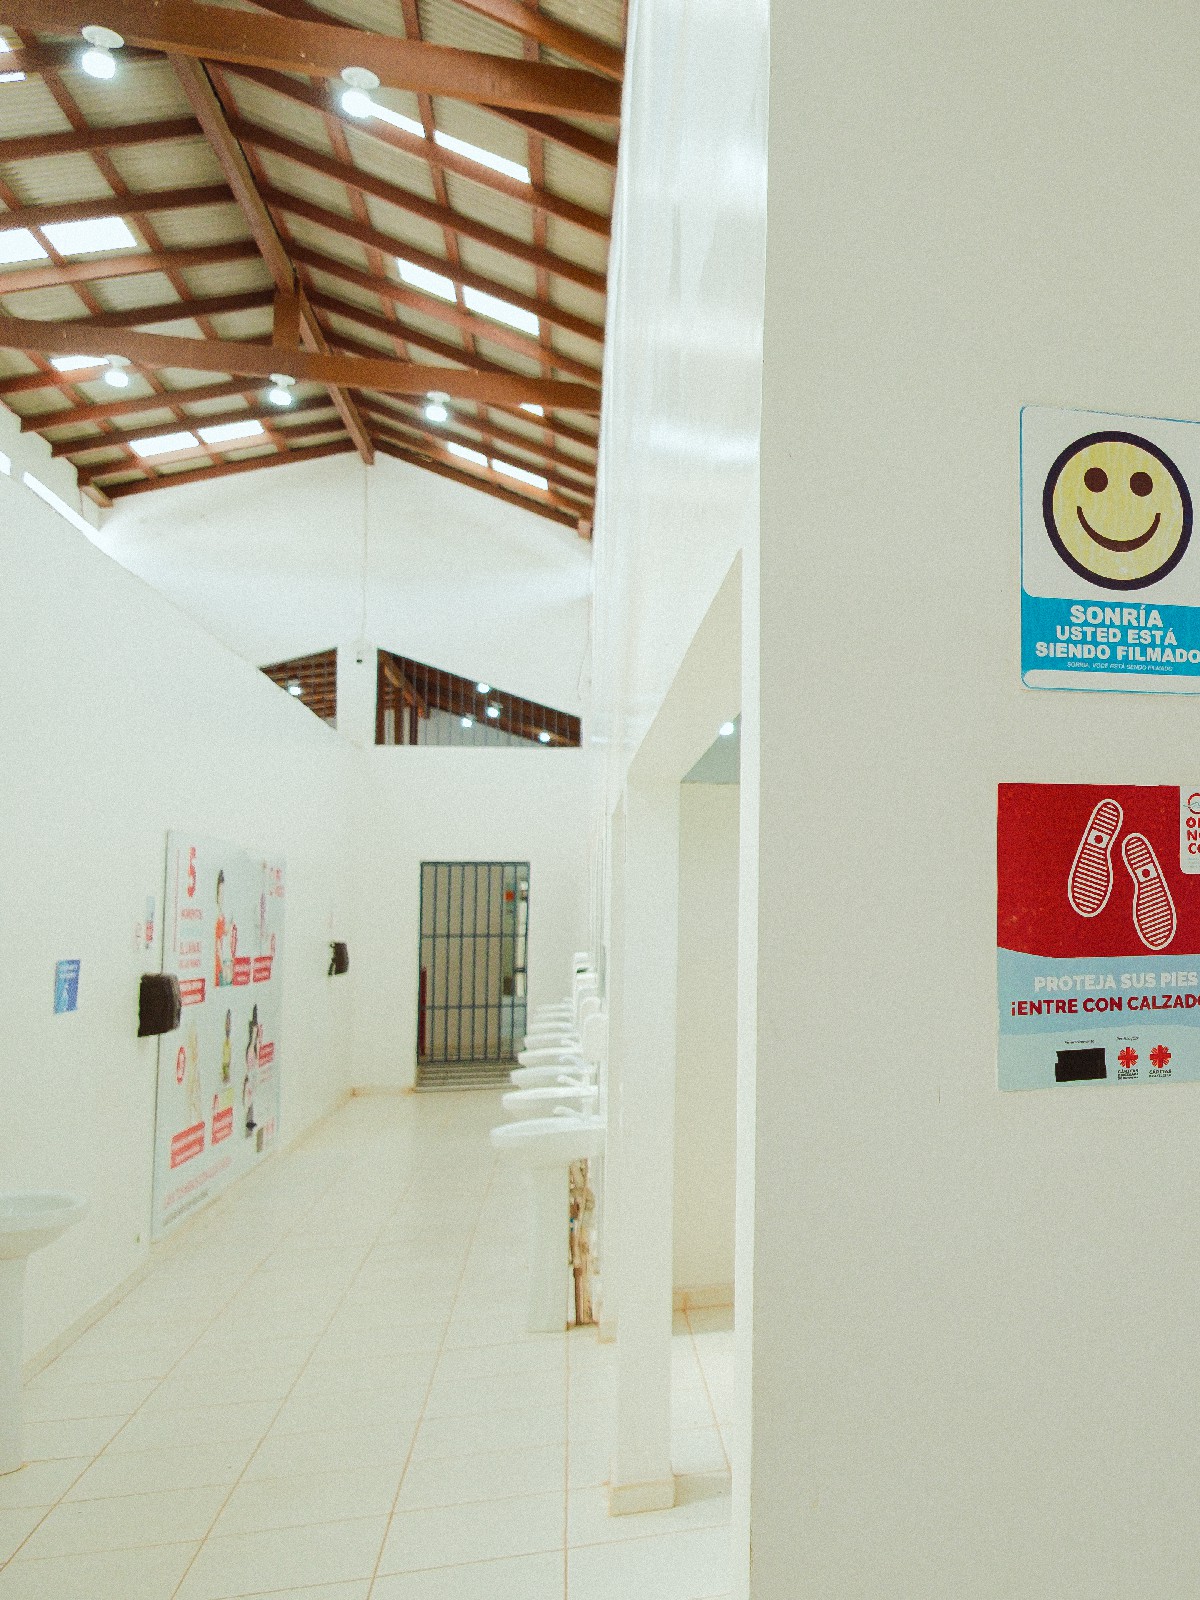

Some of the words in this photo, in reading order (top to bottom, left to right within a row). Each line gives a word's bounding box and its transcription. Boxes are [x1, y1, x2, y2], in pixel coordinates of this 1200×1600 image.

[1070, 605, 1164, 628] SONRÍA
[1056, 625, 1121, 643] USTED
[1128, 627, 1178, 646] ESTÁ
[1035, 641, 1110, 660] SIENDO
[1034, 972, 1116, 992] PROTEJA
[1122, 972, 1157, 989] SUS
[1160, 971, 1199, 988] PIES
[1011, 997, 1078, 1017] ¡ENTRE
[1082, 996, 1123, 1014] CON
